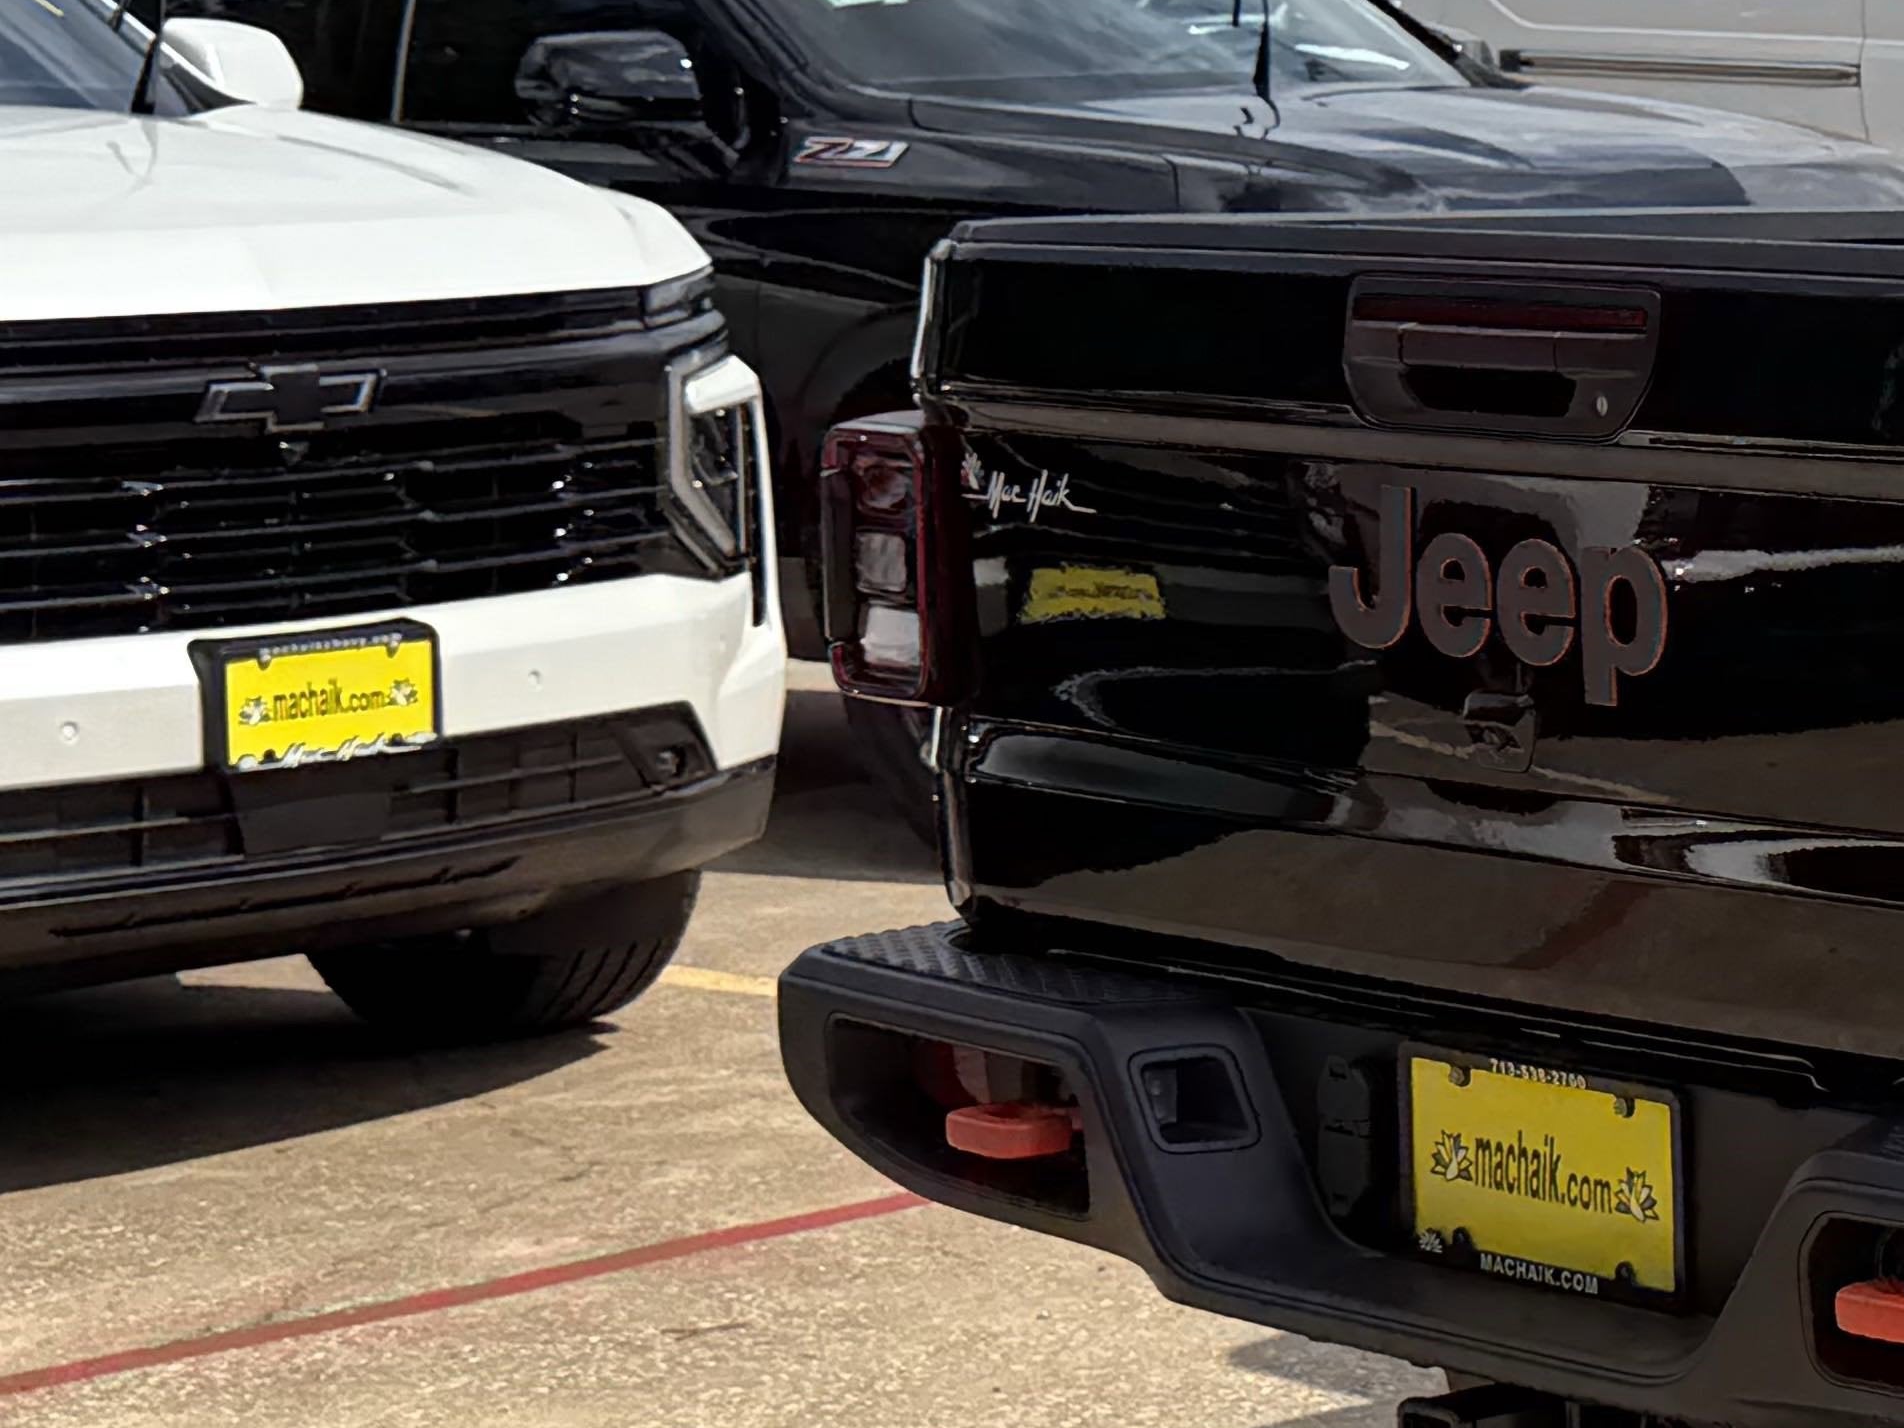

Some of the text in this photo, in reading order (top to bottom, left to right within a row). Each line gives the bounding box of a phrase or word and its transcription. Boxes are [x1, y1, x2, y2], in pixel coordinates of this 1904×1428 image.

[962, 468, 1097, 523] Mac Haik
[1329, 486, 1669, 707] Jeep
[272, 677, 386, 722] machaik.com
[1474, 1130, 1613, 1214] machaik.com
[1480, 1253, 1599, 1294] MACHAIK.COM
